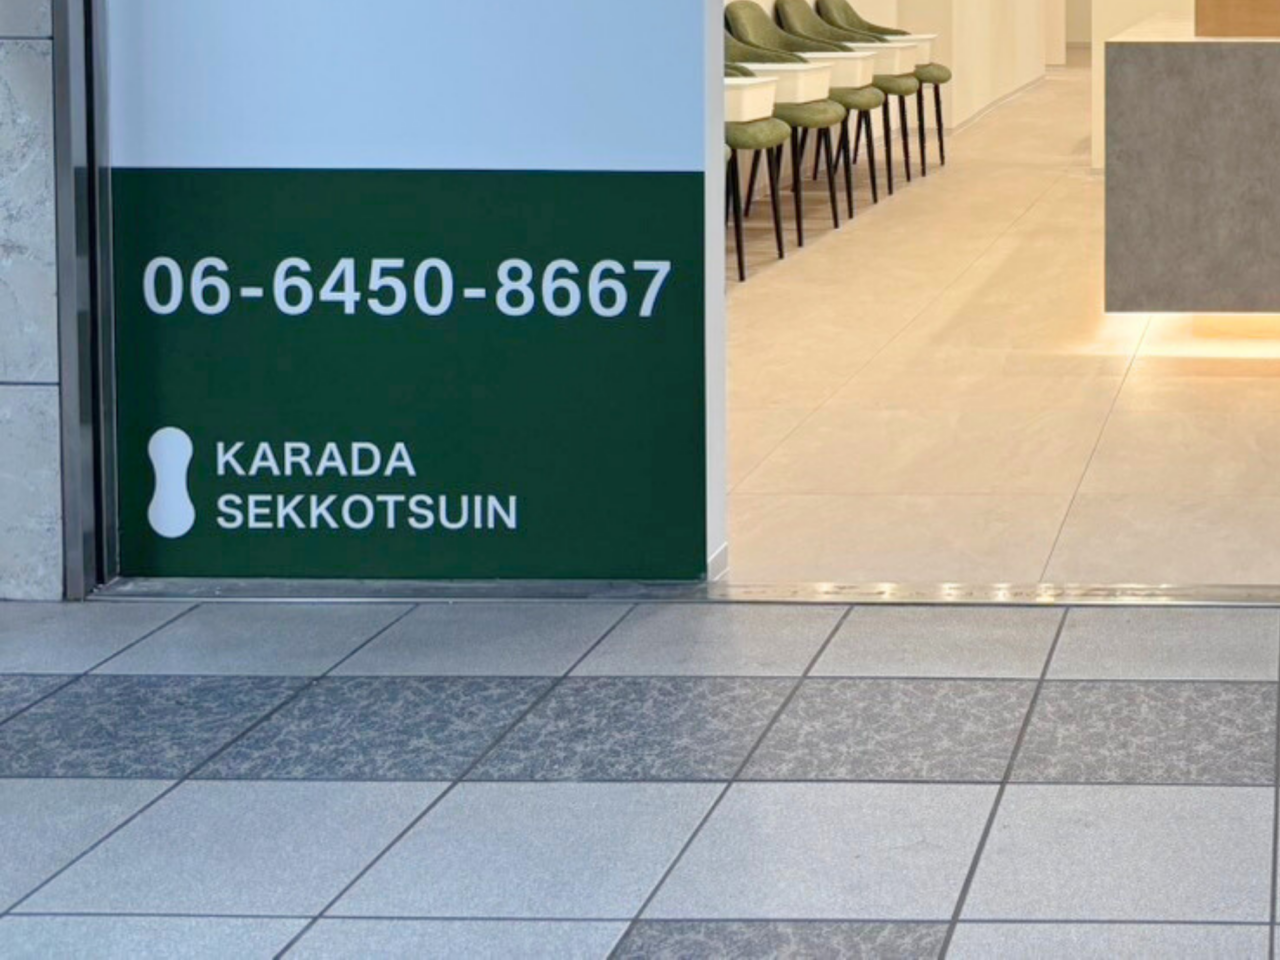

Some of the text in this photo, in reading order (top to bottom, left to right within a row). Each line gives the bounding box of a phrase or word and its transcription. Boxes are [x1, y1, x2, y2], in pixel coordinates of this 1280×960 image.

[143, 256, 671, 318] 06-6450-8667
[216, 441, 416, 477] KARADA
[216, 493, 517, 530] SEKKOTSUIN
